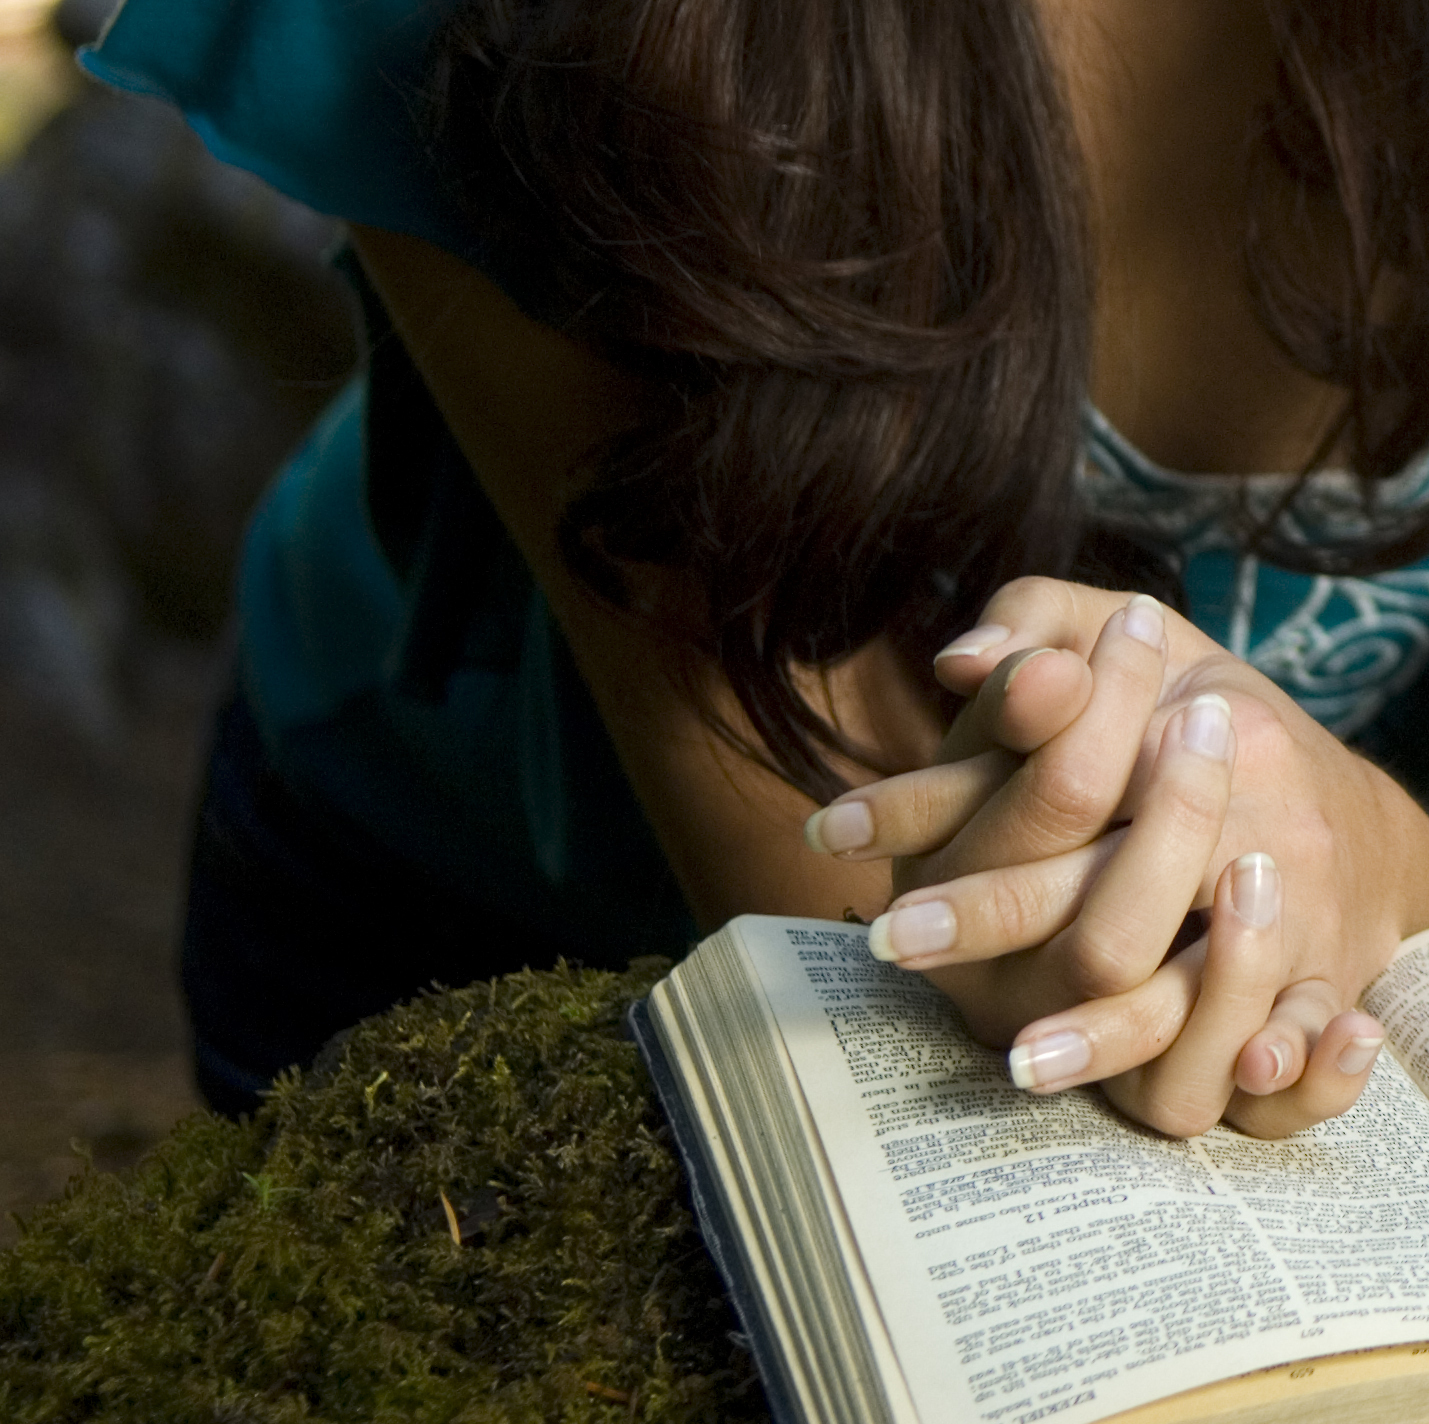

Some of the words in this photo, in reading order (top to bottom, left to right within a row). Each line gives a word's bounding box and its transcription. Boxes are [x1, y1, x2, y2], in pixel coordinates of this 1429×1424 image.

[914, 1117, 940, 1127] thy
[1081, 1186, 1106, 1197] the
[998, 1203, 1030, 1217] also
[1052, 1191, 1128, 1217] Chapter
[907, 1210, 933, 1222] the
[954, 1212, 996, 1227] came
[1022, 1211, 1045, 1225] 12
[1142, 1208, 1168, 1218] the
[914, 1224, 951, 1239] unto
[1047, 1225, 1081, 1240] that
[1065, 1229, 1101, 1244] unto
[1152, 1230, 1173, 1240] So
[1015, 1235, 1041, 1248] the
[1021, 1240, 1061, 1256] them
[969, 1258, 994, 1271] the
[998, 1252, 1016, 1263] of
[1222, 1258, 1246, 1269] the
[927, 1259, 958, 1274] had
[1028, 1258, 1061, 1273] that
[977, 1273, 1008, 1288] had
[1044, 1268, 1061, 1279] to
[1092, 1271, 1118, 1284] the
[1142, 1263, 1218, 1288] mountain
[1206, 1269, 1232, 1282] the
[1250, 1269, 1271, 1280] 23
[995, 1274, 1037, 1293] them
[1023, 1282, 1043, 1294] by
[1208, 1276, 1242, 1290] And
[1248, 1276, 1283, 1288] over
[973, 1288, 990, 1300] of
[992, 1289, 1019, 1303] the
[1092, 1283, 1138, 1302] which
[1138, 1288, 1155, 1299] of
[1177, 1285, 1203, 1298] the
[1203, 1284, 1243, 1300] them
[1226, 1292, 1252, 1305] the
[1256, 1285, 1286, 1298] and
[940, 1296, 966, 1310] the
[1006, 1292, 1043, 1309] took
[1051, 1302, 1073, 1313] on
[1109, 1294, 1133, 1308] the
[1131, 1291, 1172, 1310] glory
[1180, 1298, 1222, 1316] glory
[1253, 1294, 1290, 1307] their
[977, 1304, 1001, 1316] me
[1022, 1309, 1048, 1323] the
[1108, 1305, 1127, 1317] of
[1158, 1311, 1176, 1323] of
[1036, 1314, 1066, 1329] and
[1079, 1312, 1105, 1326] the
[1128, 1317, 1154, 1331] the
[1164, 1316, 1194, 1330] and
[1197, 1313, 1239, 1331] Then
[1229, 1319, 1254, 1331] the
[1087, 1326, 1125, 1343] God
[1133, 1325, 1159, 1339] the
[1166, 1326, 1191, 1340] did
[1183, 1327, 1223, 1344] Lord
[1213, 1330, 1249, 1345] their
[987, 1337, 1025, 1355] went
[1134, 1335, 1160, 1349] the
[1173, 1341, 1204, 1355] way
[958, 1352, 981, 1364] up
[1125, 1353, 1165, 1369] upon
[966, 1367, 995, 1383] was
[1079, 1367, 1118, 1385] their
[973, 1390, 994, 1402] up
[1037, 1382, 1073, 1399] own
